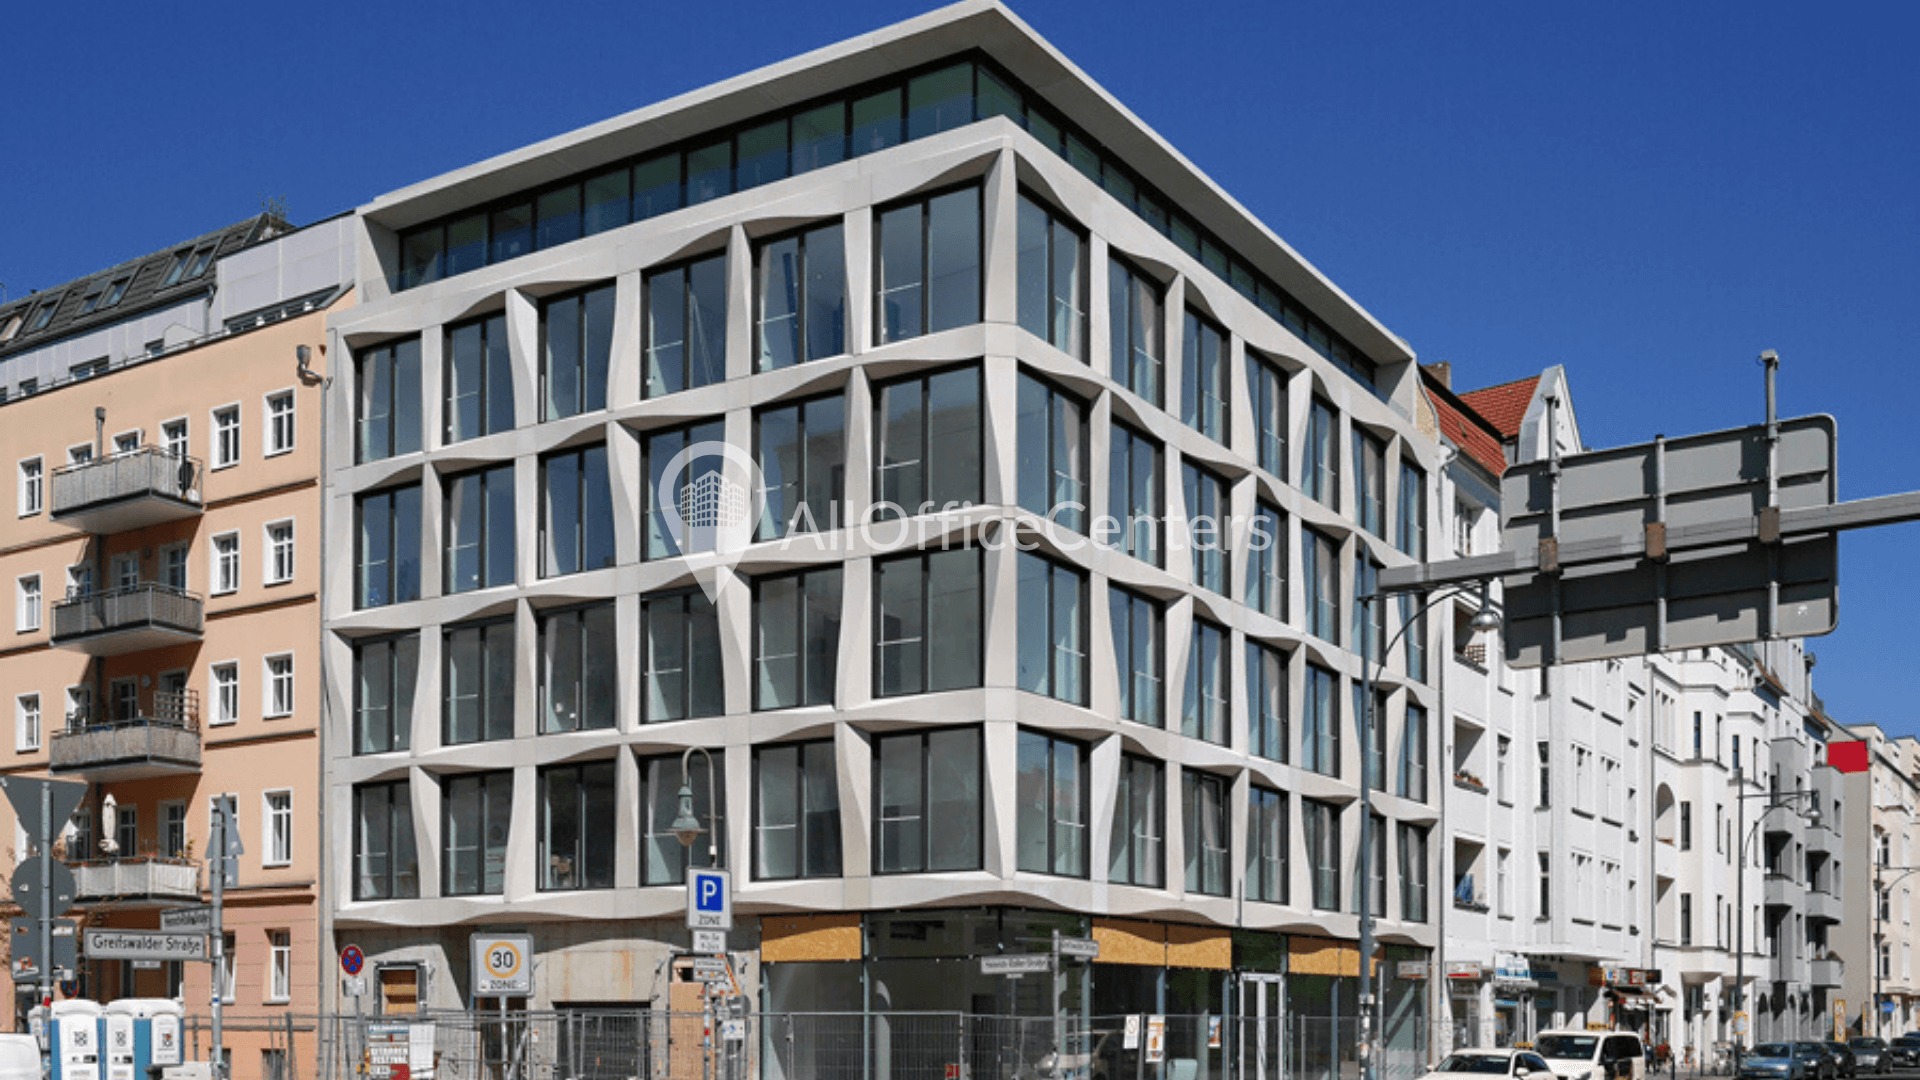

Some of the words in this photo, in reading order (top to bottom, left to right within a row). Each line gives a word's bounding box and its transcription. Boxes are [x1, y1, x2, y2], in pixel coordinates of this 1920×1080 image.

[702, 880, 717, 906] P
[93, 934, 162, 950] Greifswalder
[492, 951, 513, 968] 30
[490, 980, 517, 989] ZONE
